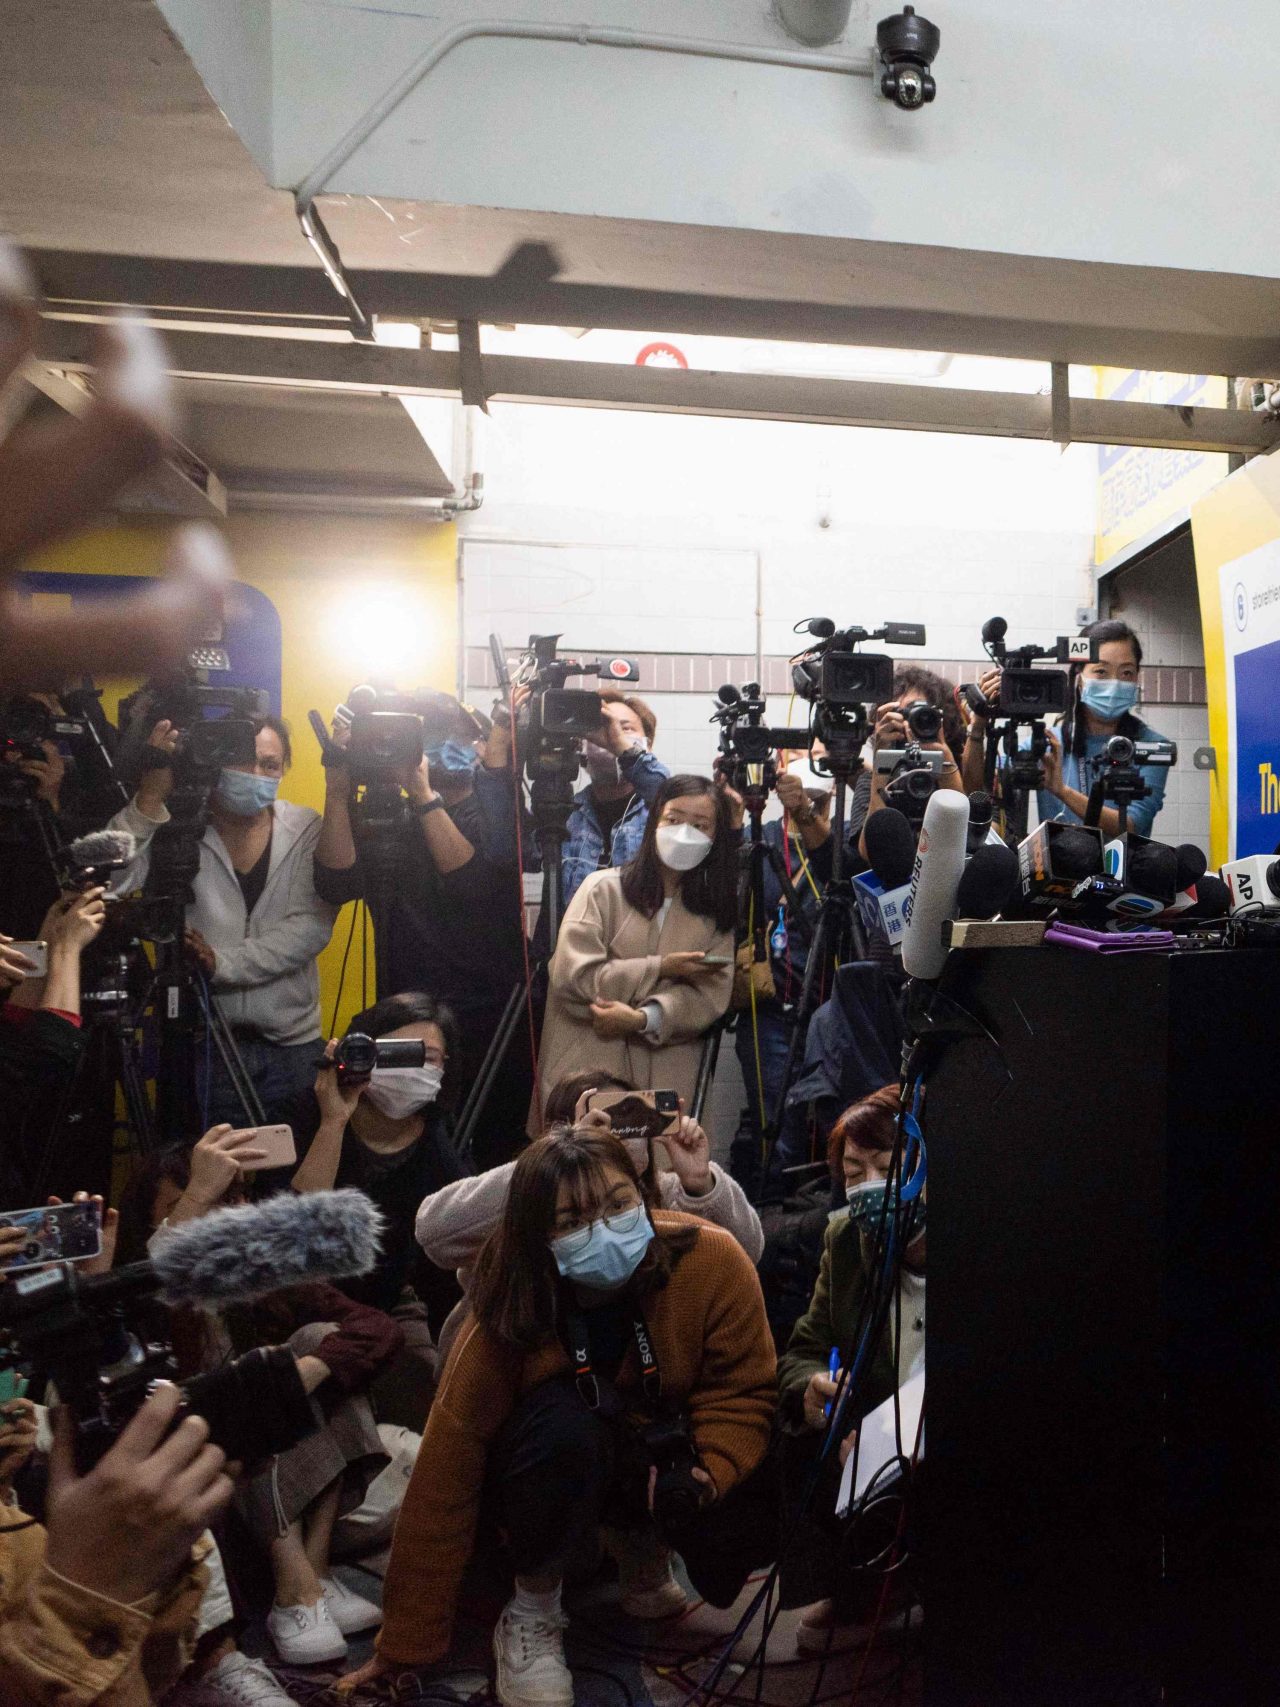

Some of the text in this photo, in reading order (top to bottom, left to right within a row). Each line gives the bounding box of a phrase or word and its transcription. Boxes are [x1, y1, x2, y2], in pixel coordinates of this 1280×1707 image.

[1070, 642, 1088, 654] AP
[905, 855, 923, 927] REUTERS
[1236, 873, 1254, 900] AP
[633, 1321, 653, 1364] SONY
